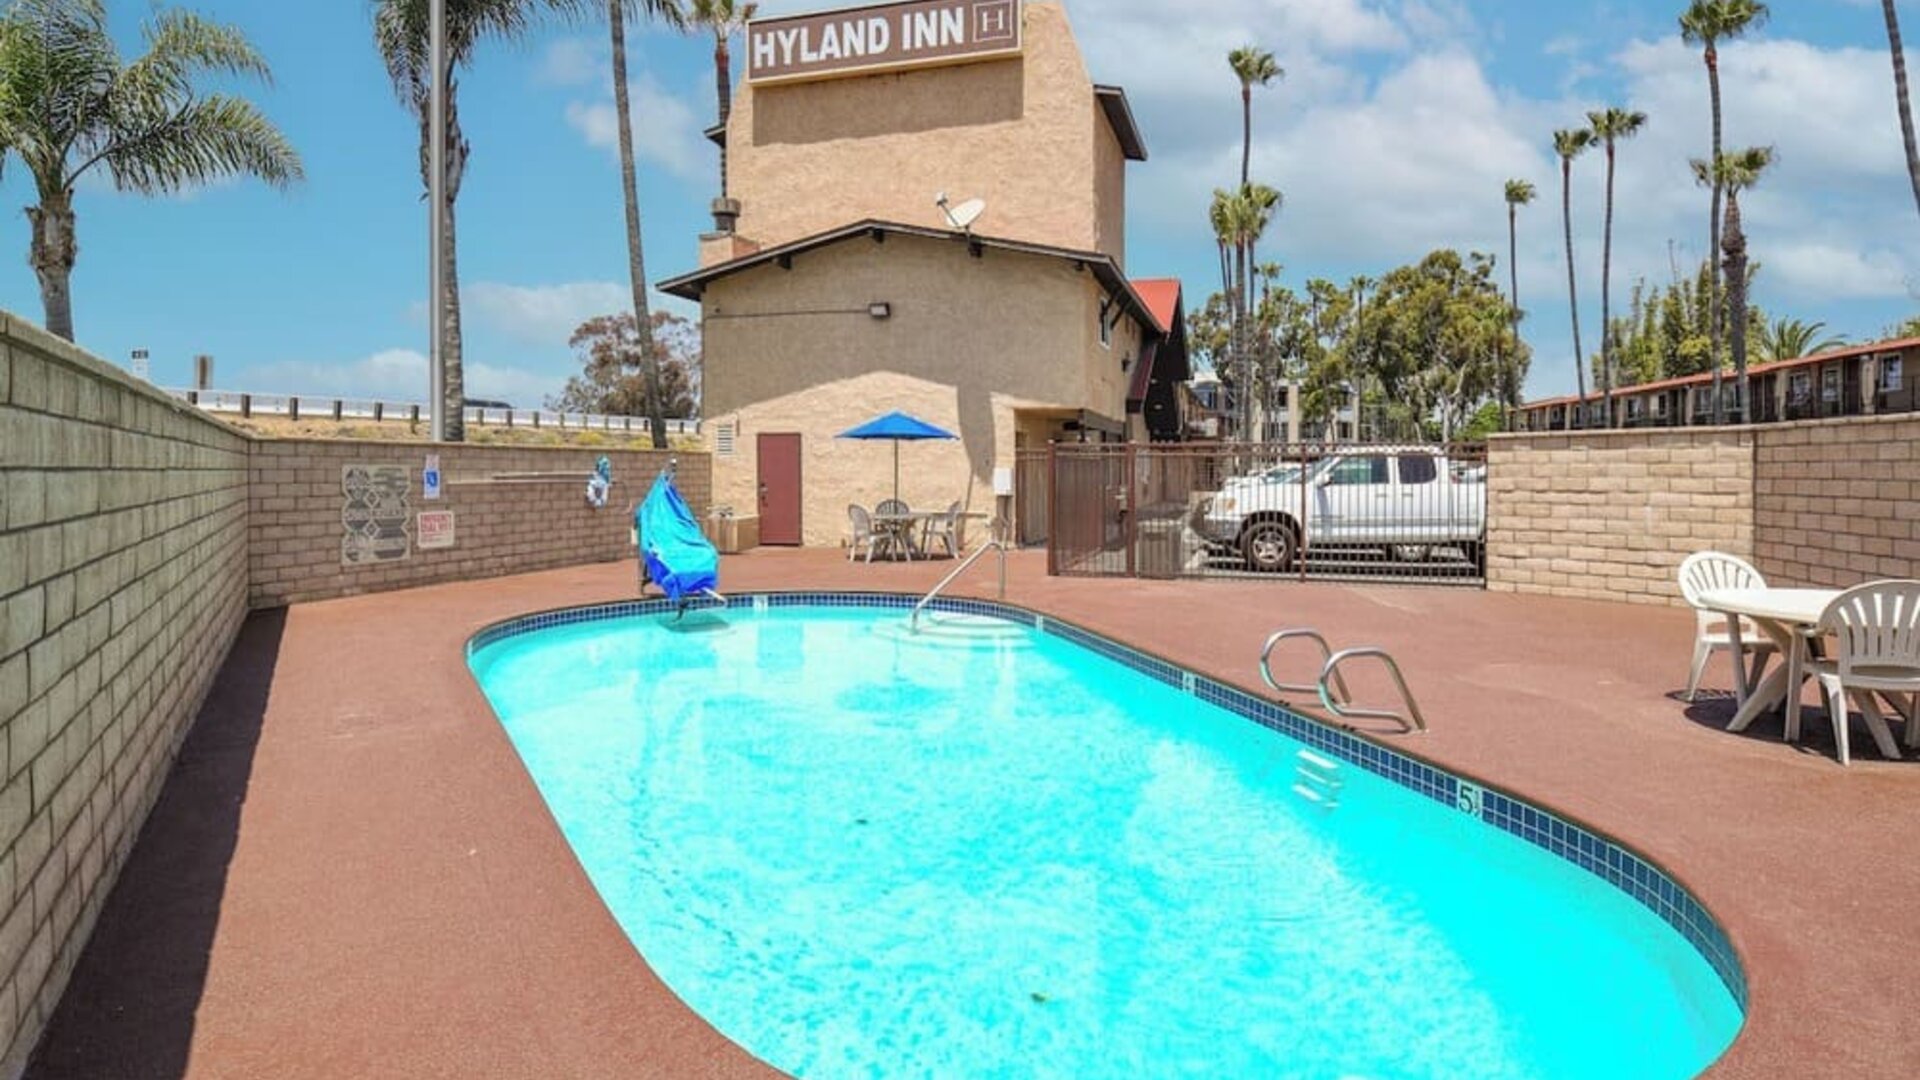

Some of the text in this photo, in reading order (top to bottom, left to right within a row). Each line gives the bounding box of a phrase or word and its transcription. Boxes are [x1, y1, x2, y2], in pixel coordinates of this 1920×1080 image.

[753, 6, 1004, 69] HYLAND INN H
